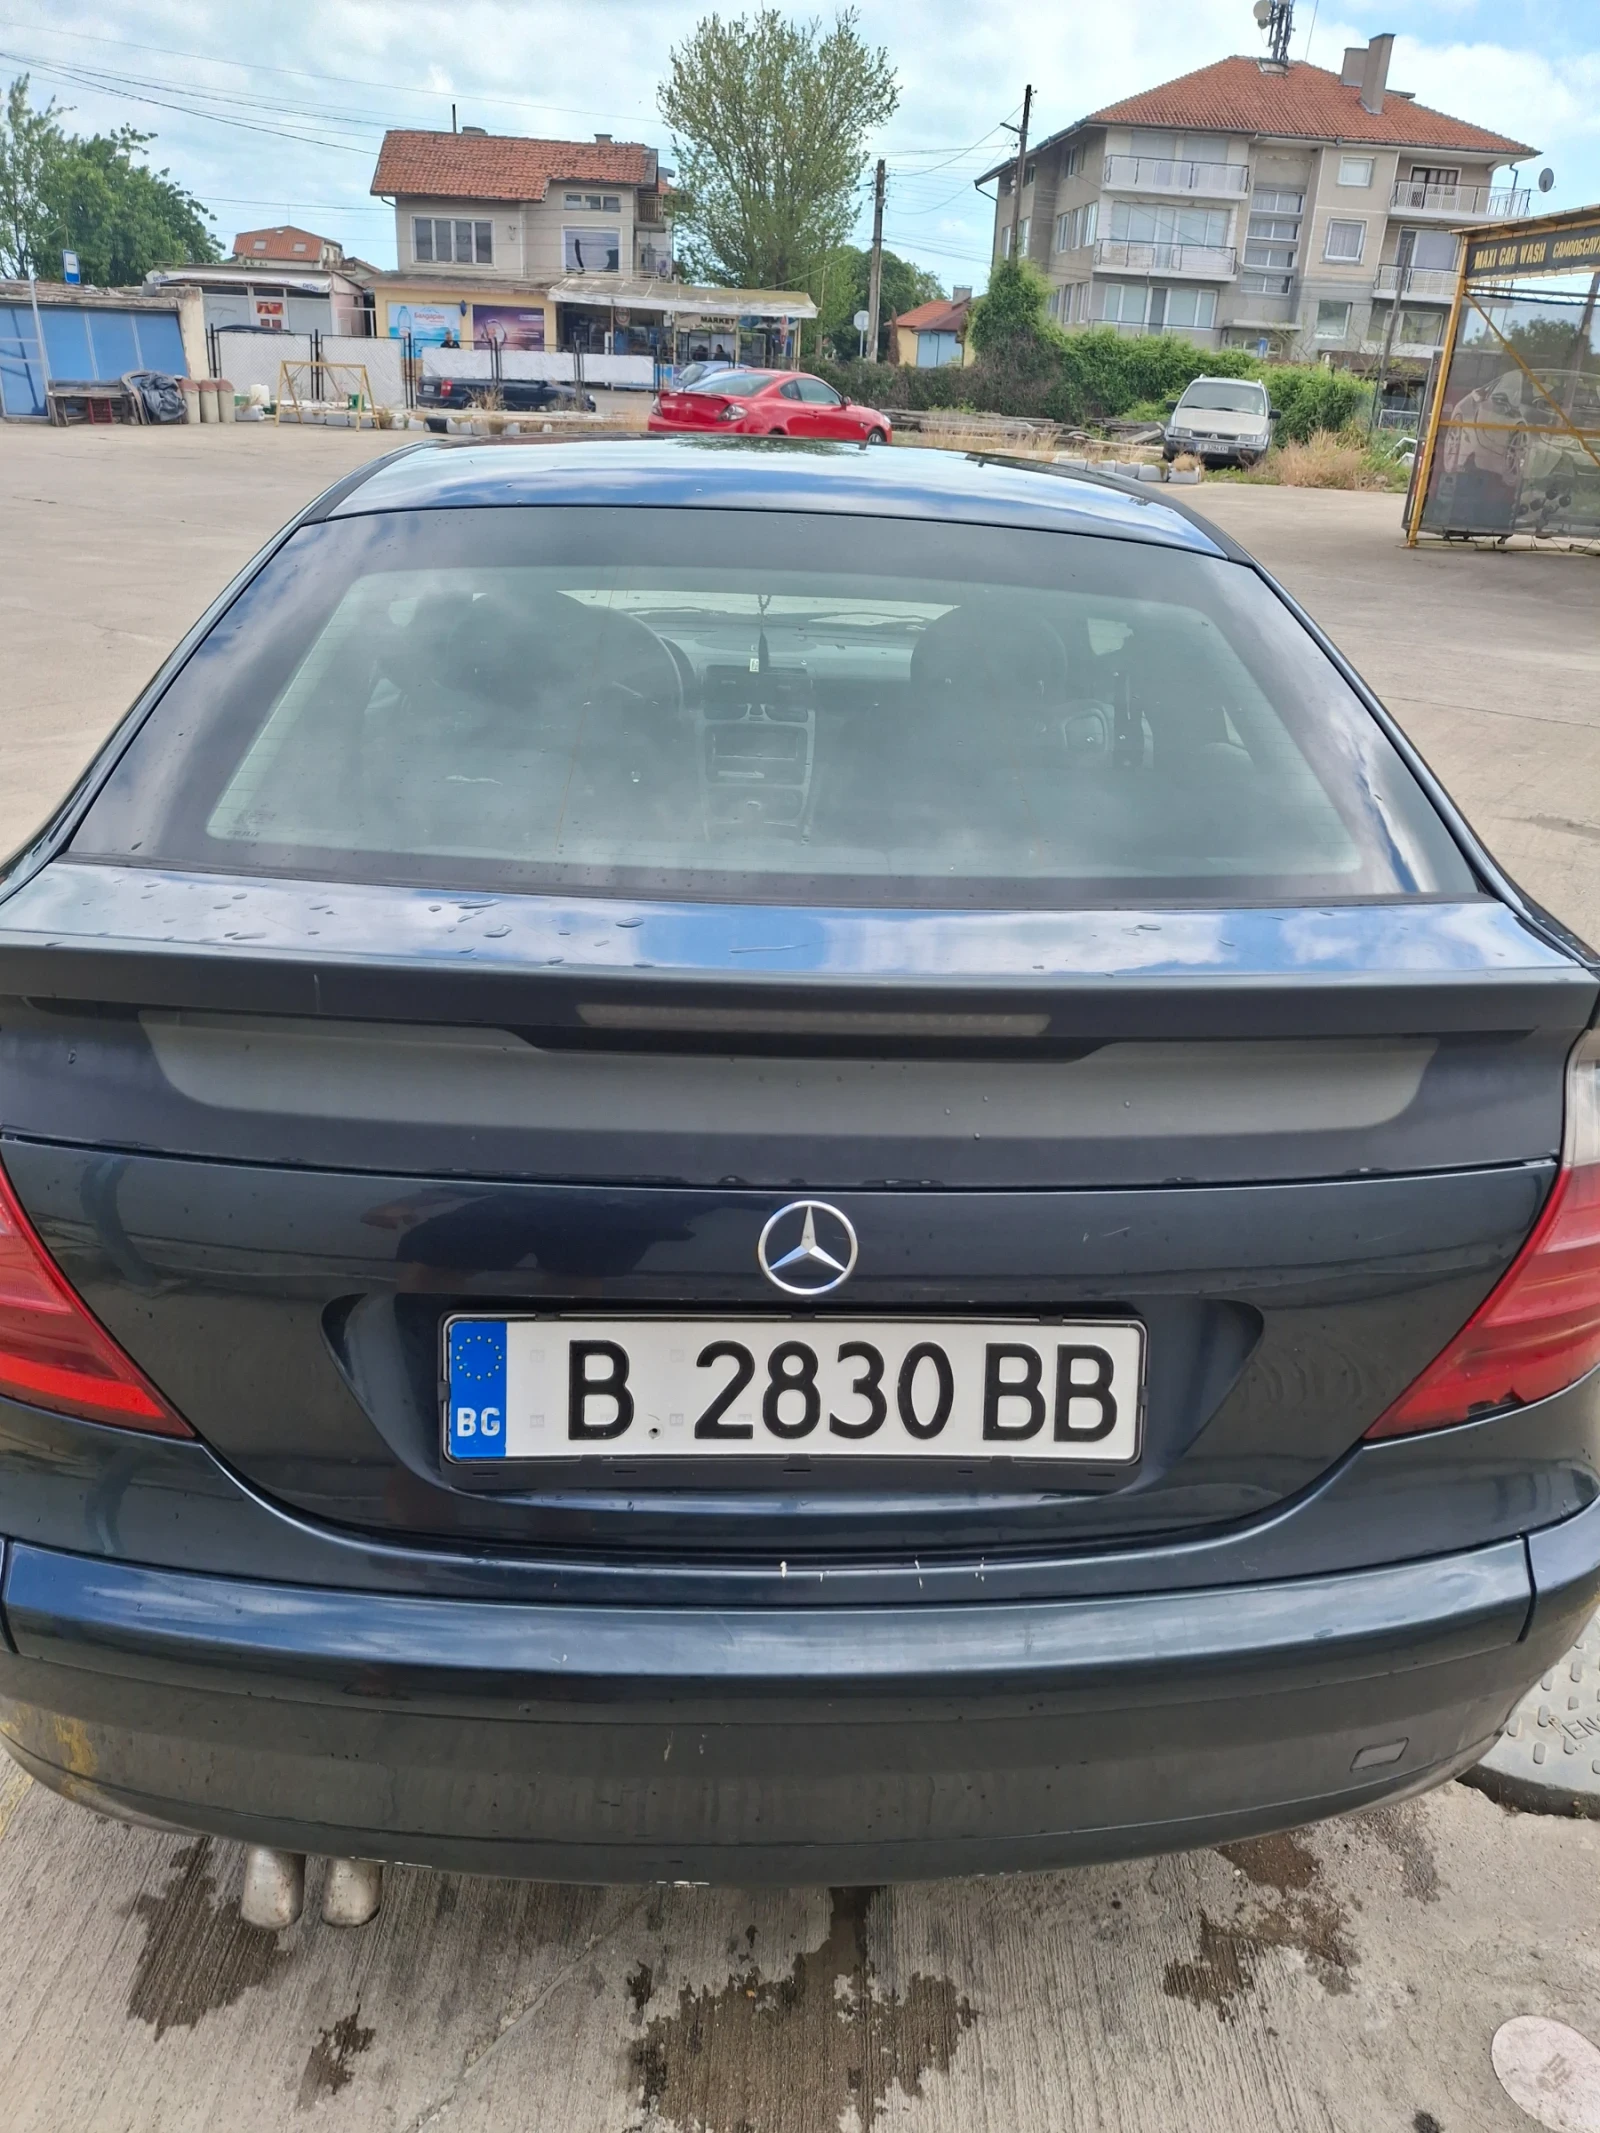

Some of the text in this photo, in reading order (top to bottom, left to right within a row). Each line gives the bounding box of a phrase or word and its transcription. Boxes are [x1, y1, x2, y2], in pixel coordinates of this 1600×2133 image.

[1474, 242, 1547, 269] MAXI CAR WASH
[700, 316, 736, 325] MARKET
[568, 1339, 1118, 1442] B 2830 BB
[456, 1407, 501, 1437] BG
